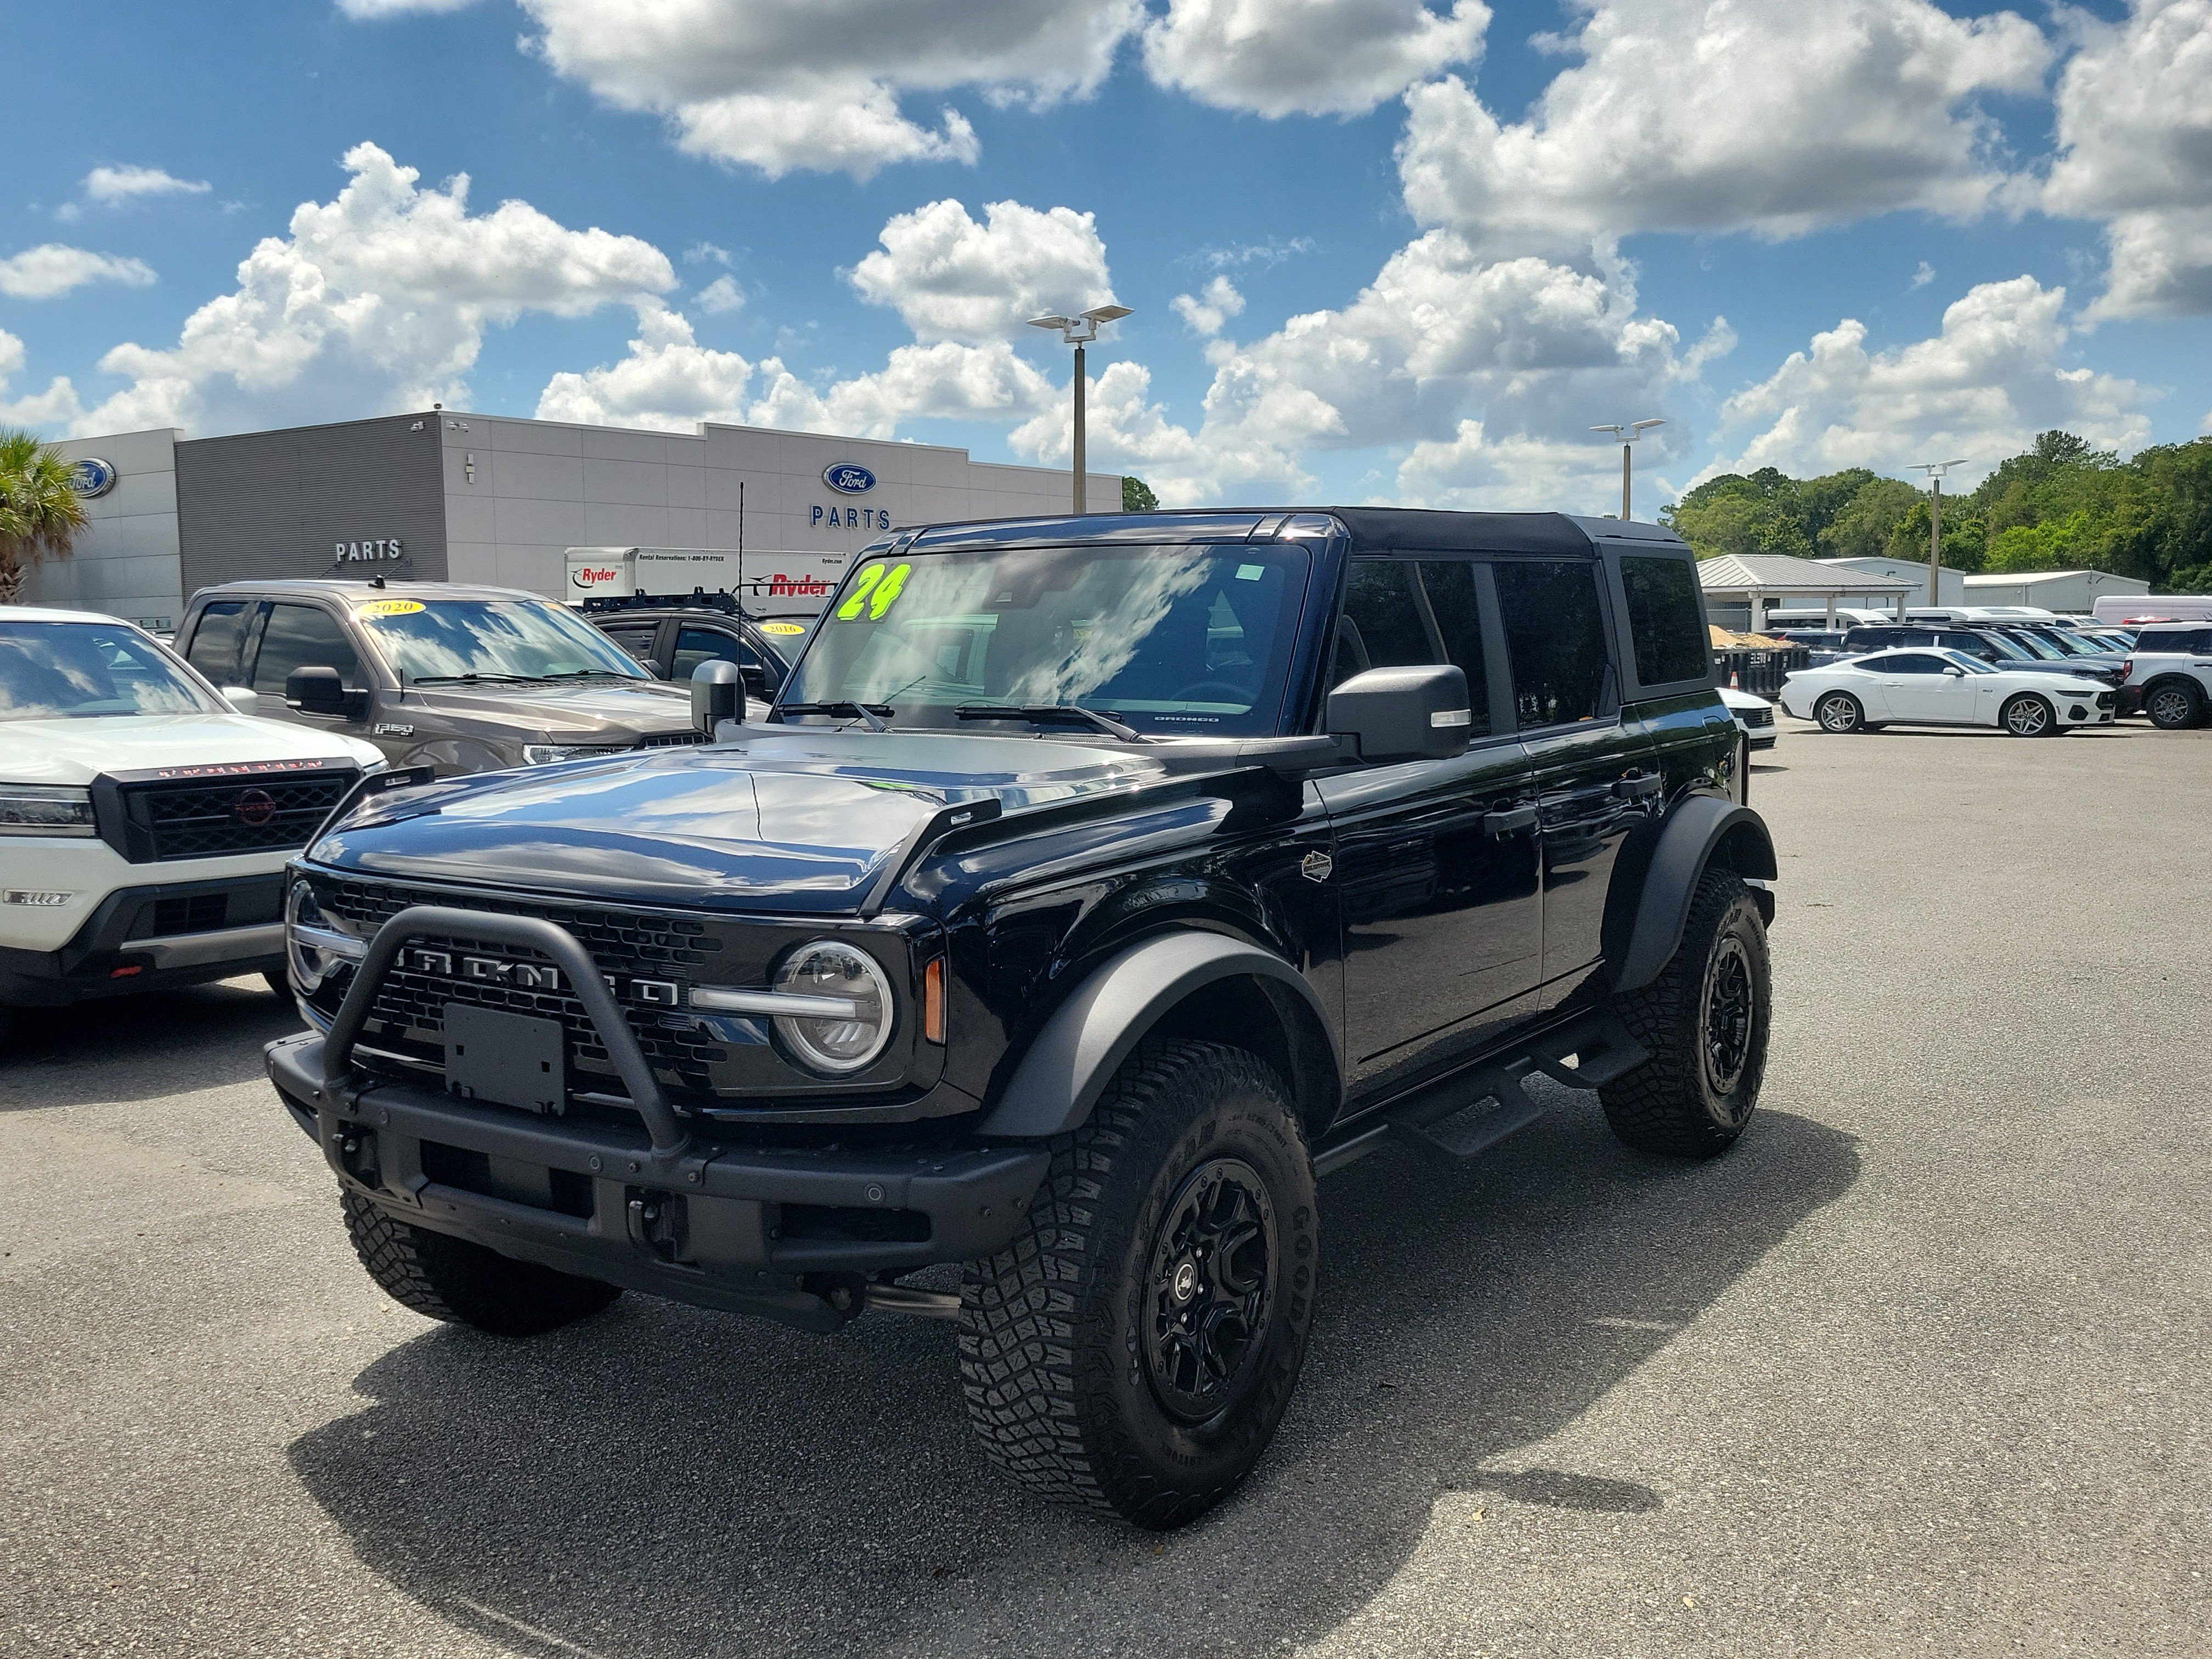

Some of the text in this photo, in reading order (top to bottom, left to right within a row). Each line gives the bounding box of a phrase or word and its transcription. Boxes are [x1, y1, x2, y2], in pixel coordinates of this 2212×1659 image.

[839, 470, 867, 488] Ford
[811, 505, 890, 531] PARTS
[336, 539, 400, 562] PARTS
[582, 567, 616, 584] Ryder
[771, 574, 830, 597] Ryder
[837, 563, 911, 620] 24
[372, 602, 413, 613] 2020
[769, 625, 796, 633] 2016
[397, 948, 679, 1006] RONO
